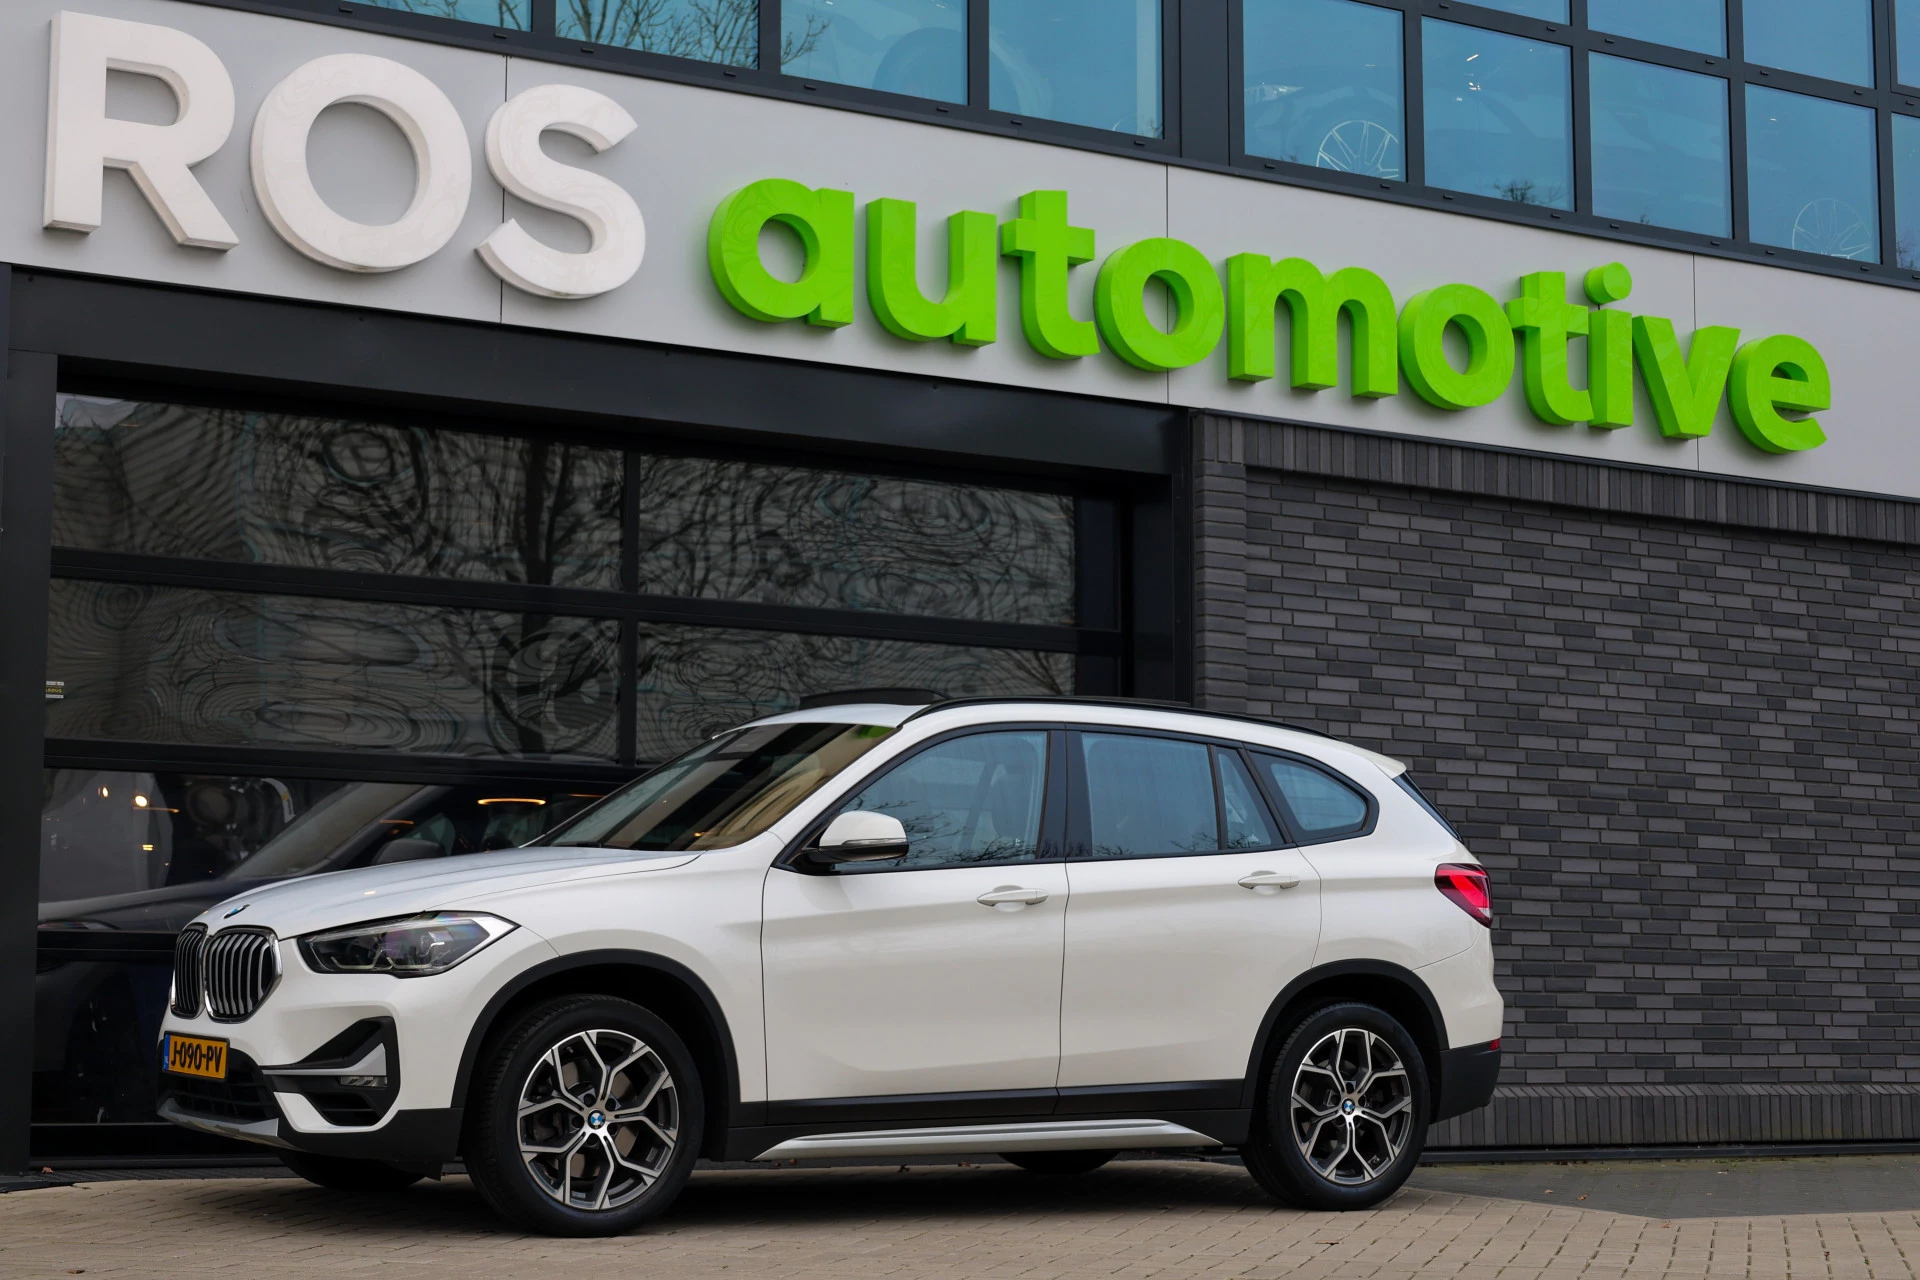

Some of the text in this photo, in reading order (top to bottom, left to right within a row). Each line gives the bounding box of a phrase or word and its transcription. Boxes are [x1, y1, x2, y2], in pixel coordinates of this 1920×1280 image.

[43, 10, 1831, 454] ROS automotive
[170, 1040, 223, 1073] J-090-PV
